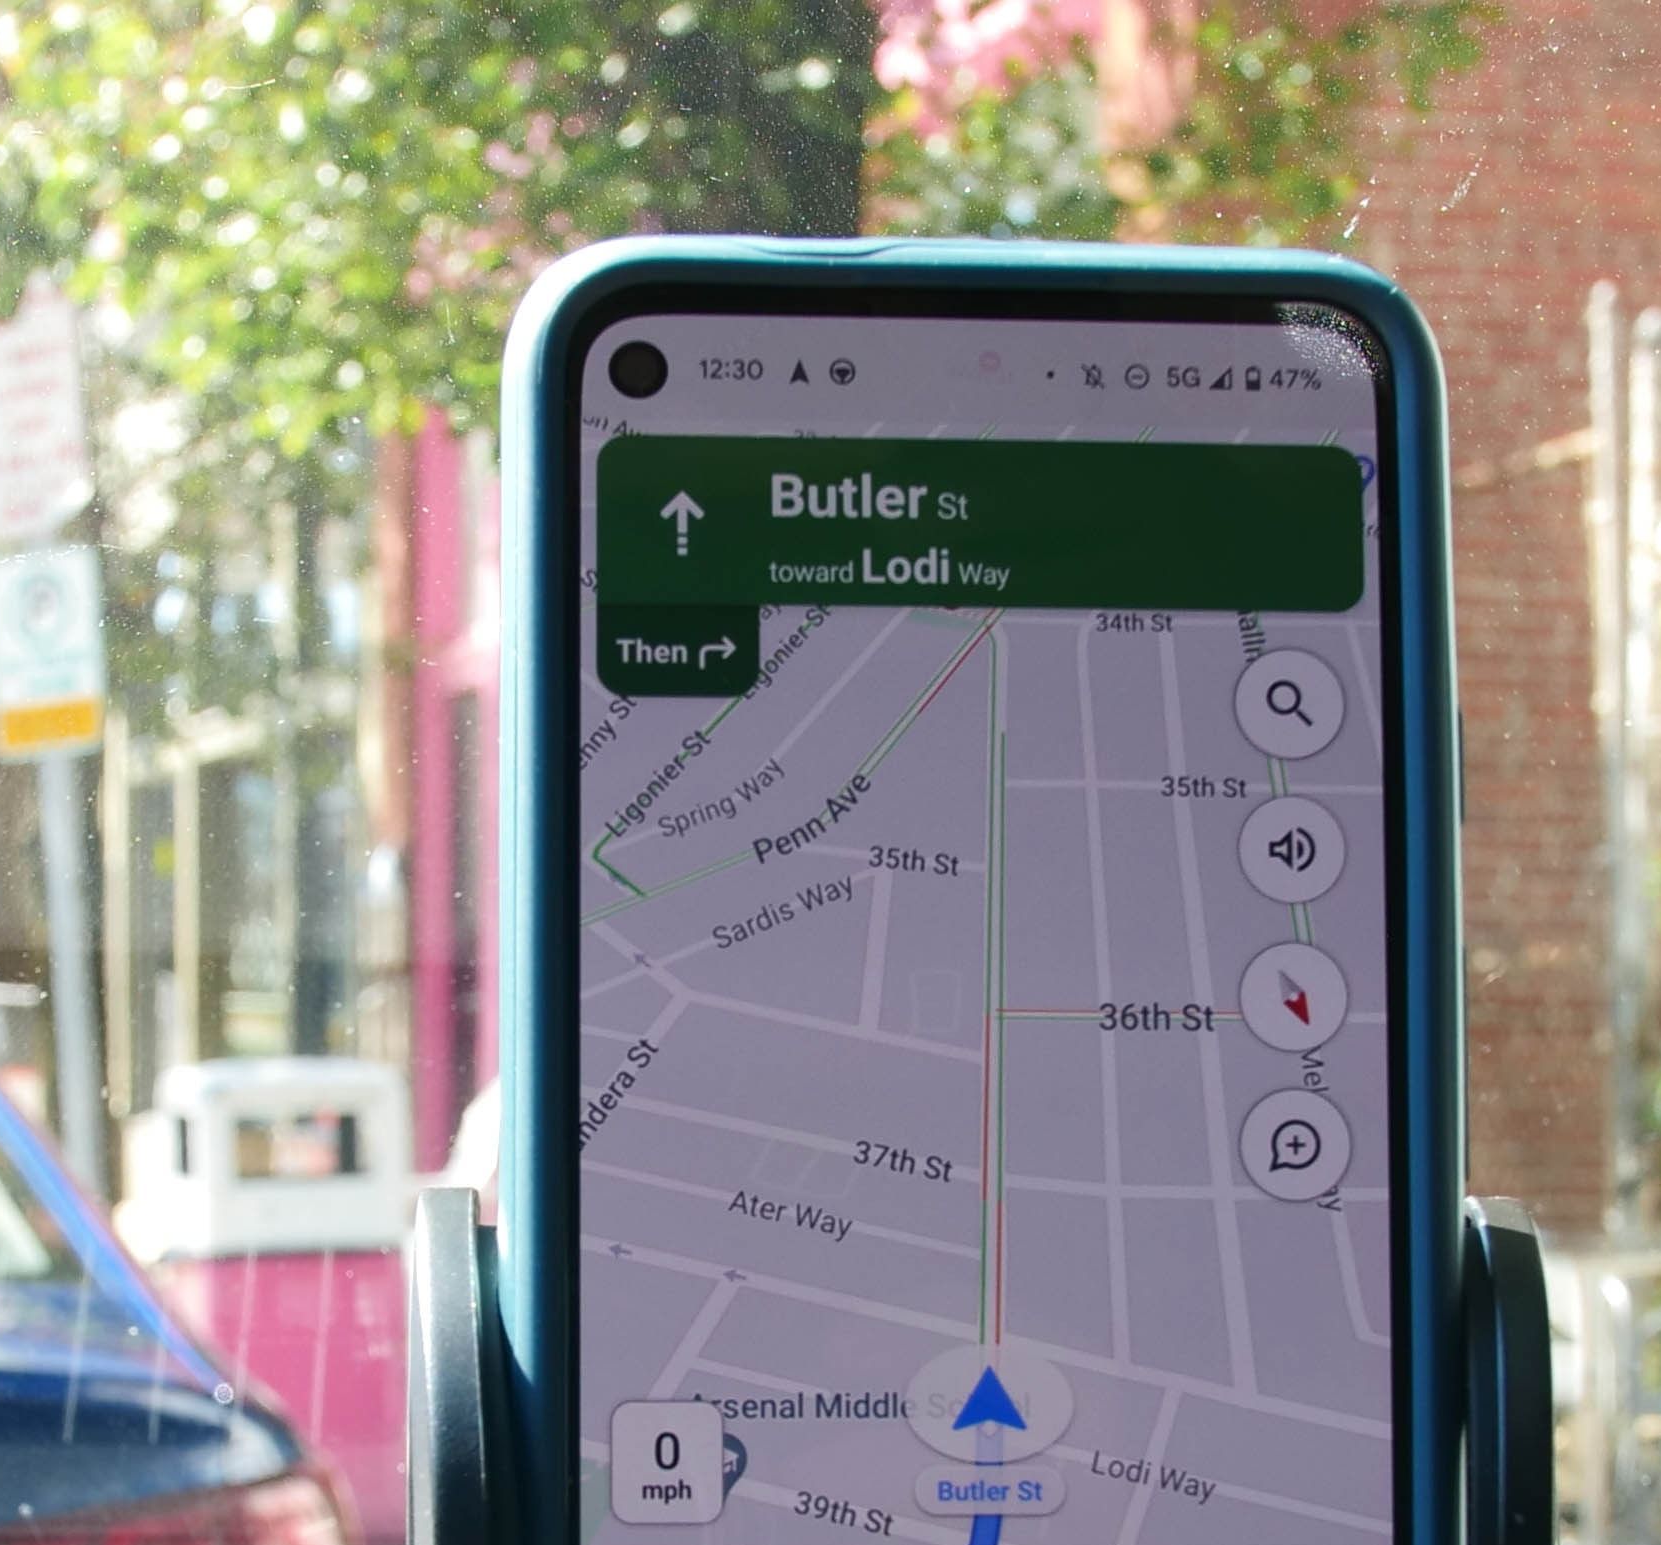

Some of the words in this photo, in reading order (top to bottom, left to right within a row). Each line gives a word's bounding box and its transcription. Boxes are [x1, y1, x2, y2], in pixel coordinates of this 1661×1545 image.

[698, 359, 764, 381] 12:30
[1166, 365, 1201, 389] 5G
[1269, 369, 1322, 391] 47%
[771, 472, 928, 520] Butler
[937, 491, 969, 521] St
[769, 560, 854, 584] toward
[862, 547, 950, 585] Lodi
[958, 562, 1011, 591] Way
[804, 604, 832, 628] St
[1095, 612, 1145, 633] 34th
[1150, 613, 1174, 634] St
[615, 637, 688, 664] Then
[608, 695, 638, 721] St
[604, 758, 687, 839] Ligonier
[681, 730, 712, 758] St
[657, 796, 738, 838] Spring
[735, 756, 786, 804] Way
[1160, 776, 1215, 798] 35th
[1222, 777, 1247, 799] St
[752, 816, 827, 865] Penn
[825, 773, 872, 823] Ave
[868, 845, 926, 873] 35th
[932, 852, 960, 878] St
[712, 903, 796, 949] Sardis
[796, 875, 853, 912] Way
[1098, 1002, 1172, 1032] 36th
[1181, 1003, 1216, 1033] St
[626, 1038, 660, 1069] St
[852, 1140, 916, 1175] 37th
[923, 1155, 953, 1183] St
[727, 1190, 788, 1223] Ater
[794, 1203, 854, 1243] Way
[654, 1431, 681, 1471] 0
[641, 1478, 693, 1505] mph
[936, 1480, 1009, 1502] Butler
[1016, 1480, 1043, 1503] St
[1090, 1450, 1152, 1485] Lodi
[1159, 1465, 1217, 1506] Way
[793, 1490, 857, 1528] 39th
[863, 1508, 894, 1537] St
